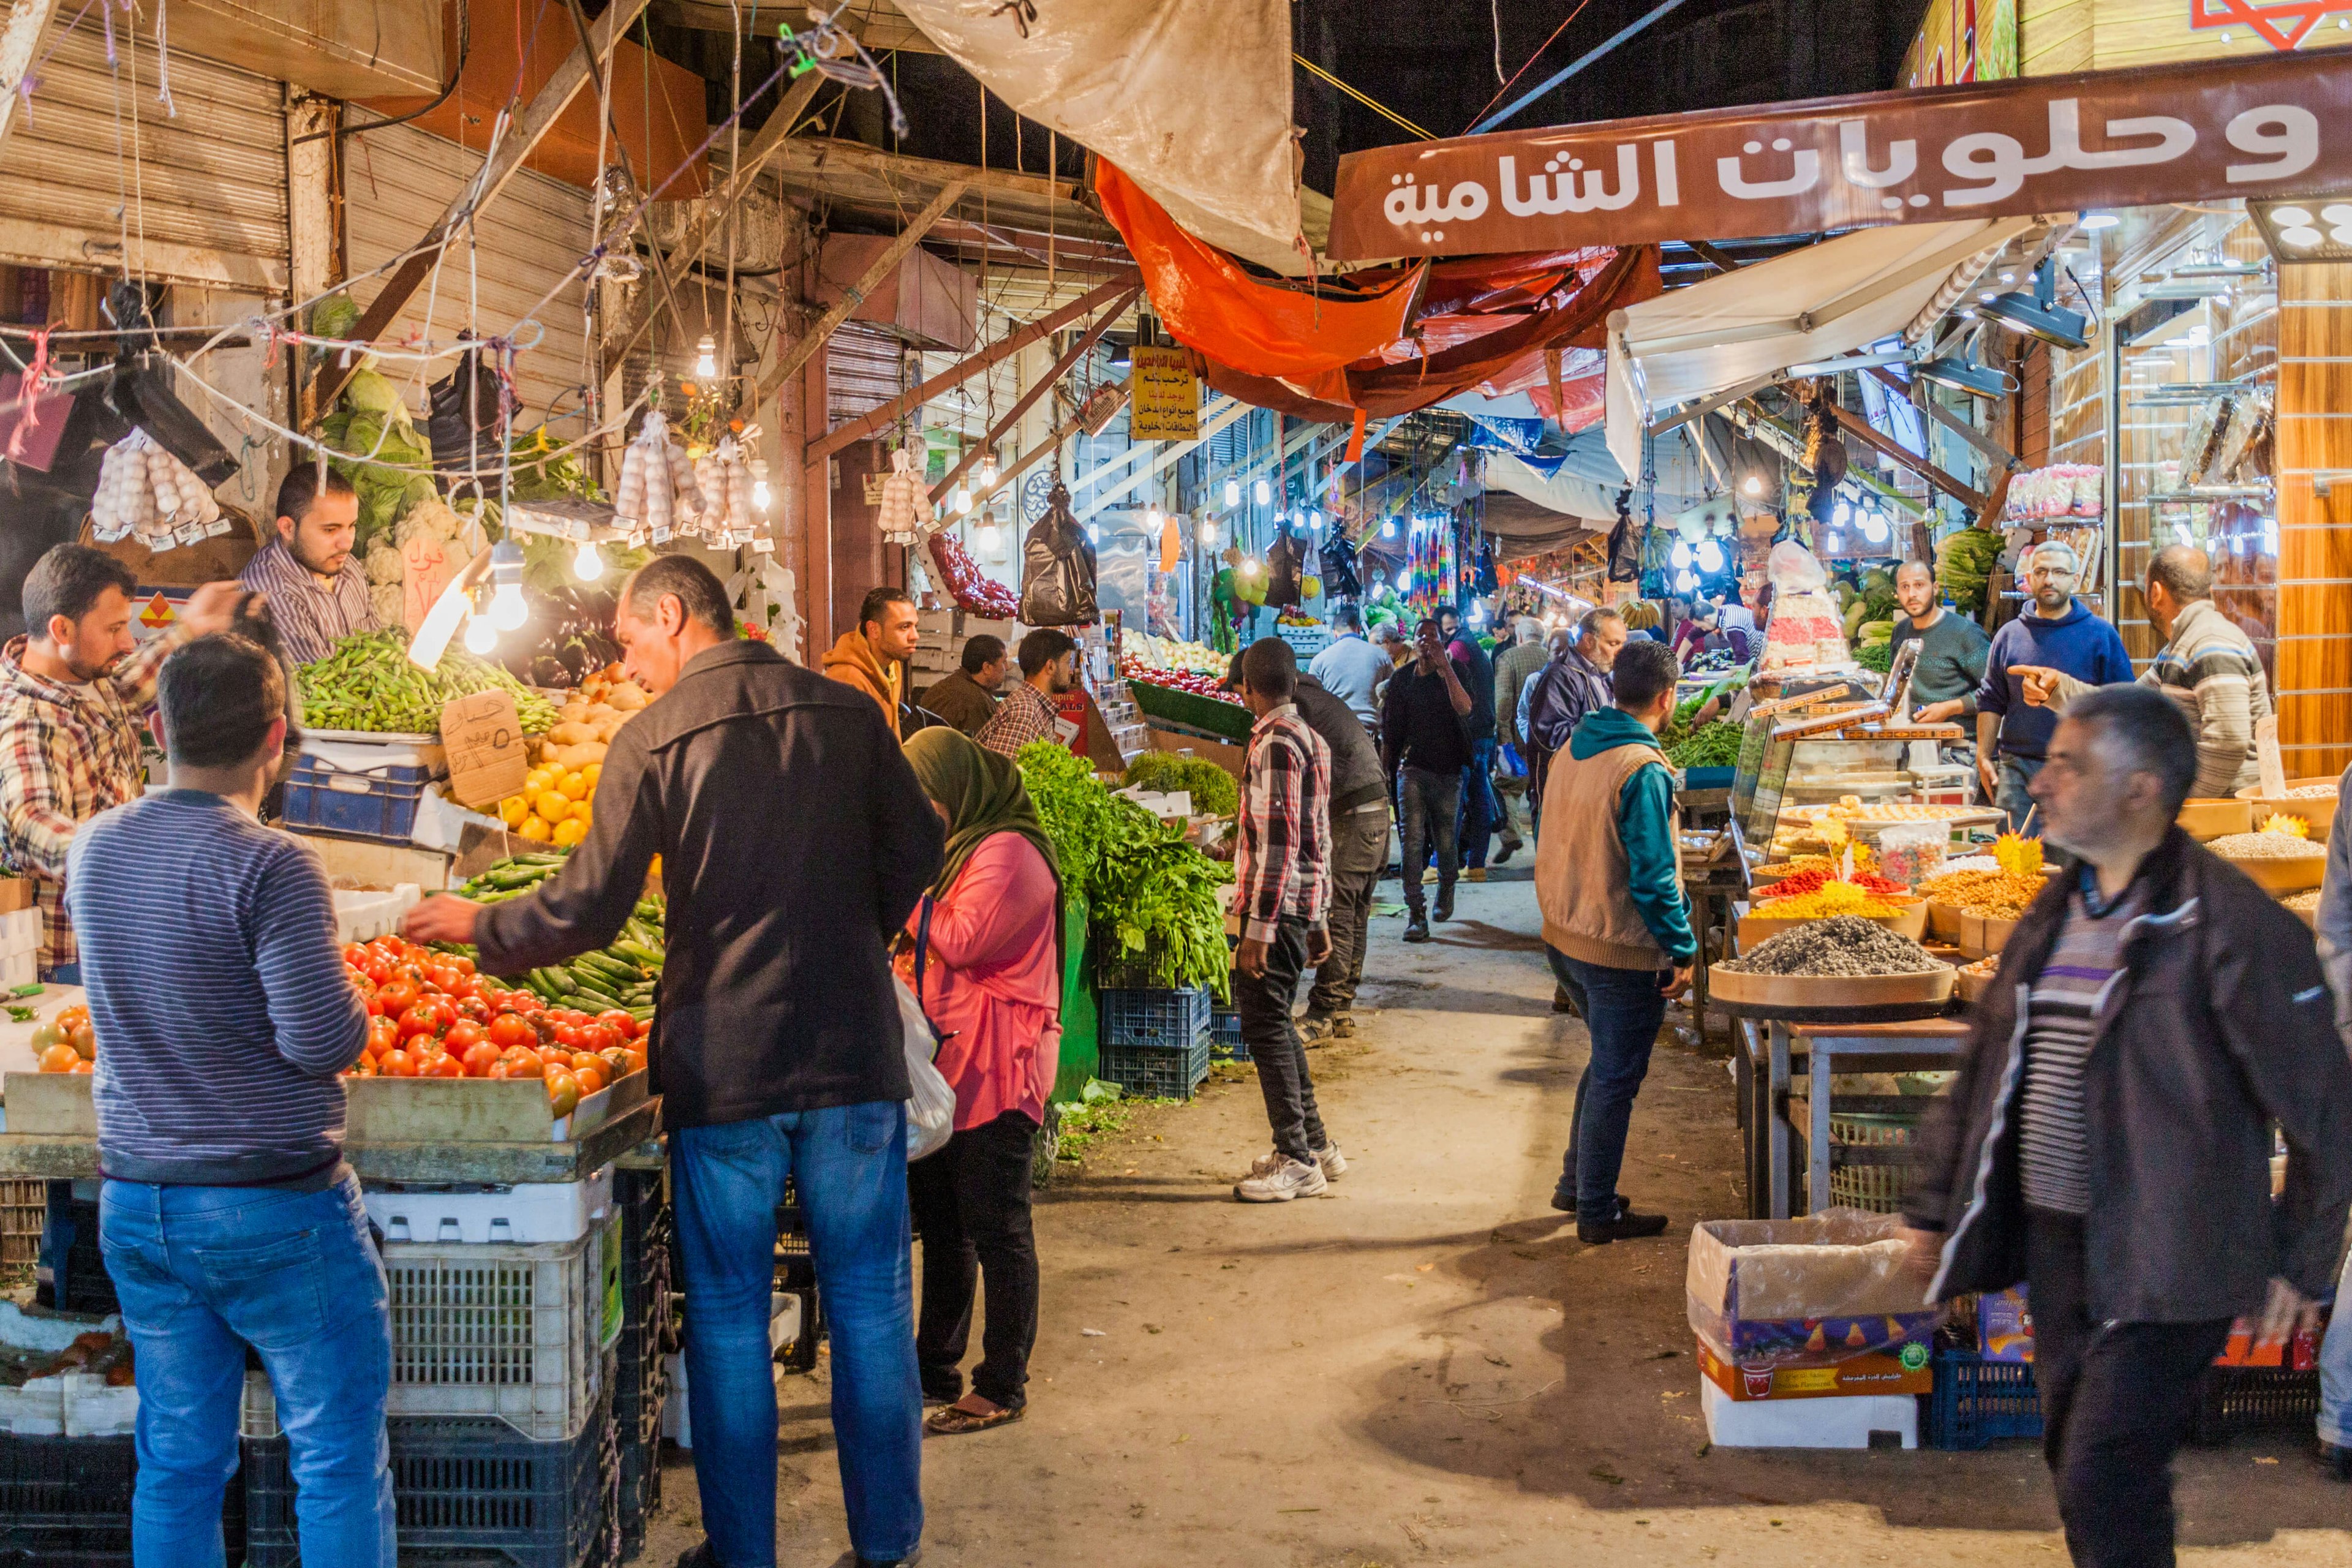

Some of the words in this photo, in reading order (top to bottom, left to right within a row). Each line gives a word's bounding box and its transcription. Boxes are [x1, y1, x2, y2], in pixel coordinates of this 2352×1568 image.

[1717, 99, 2319, 209] وحلويات
[1384, 140, 1679, 243] الشامية
[1163, 374, 1188, 386] ترحب
[1167, 392, 1185, 402] يوجد
[1177, 408, 1195, 419] جميع
[409, 541, 444, 571] فول
[1052, 693, 1074, 703] mpire
[1060, 702, 1084, 712] ALS
